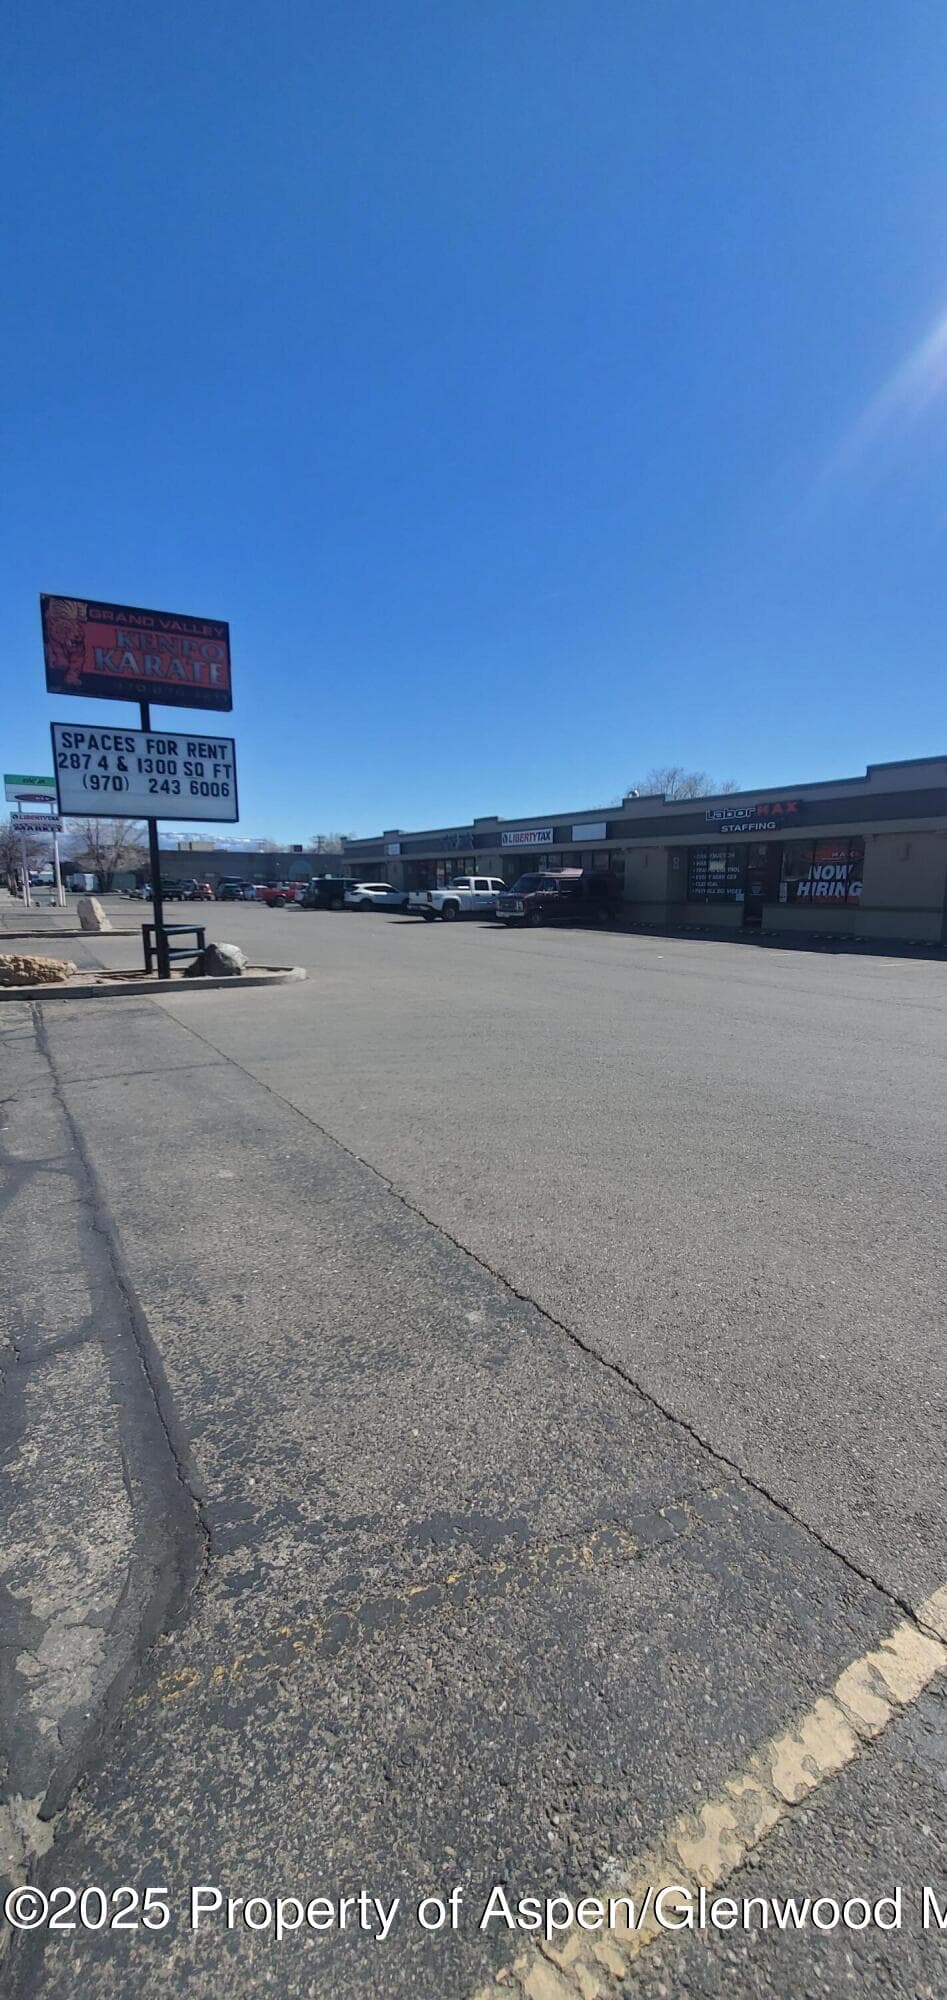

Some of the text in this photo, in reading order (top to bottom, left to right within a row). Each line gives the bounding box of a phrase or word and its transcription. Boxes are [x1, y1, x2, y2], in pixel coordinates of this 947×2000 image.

[88, 608, 225, 638] GRAND VALLEY
[115, 628, 224, 661] KENPO
[94, 647, 225, 685] KARATE
[61, 731, 228, 760] SPACES FOR RENT
[116, 755, 129, 772] &
[137, 757, 177, 776] 1300
[183, 761, 205, 778] SQ
[213, 763, 232, 779] FT
[82, 774, 230, 798] (970) 243 6006
[720, 821, 777, 833] STAFFING
[808, 864, 854, 880] NOW
[797, 881, 864, 896] HIRING
